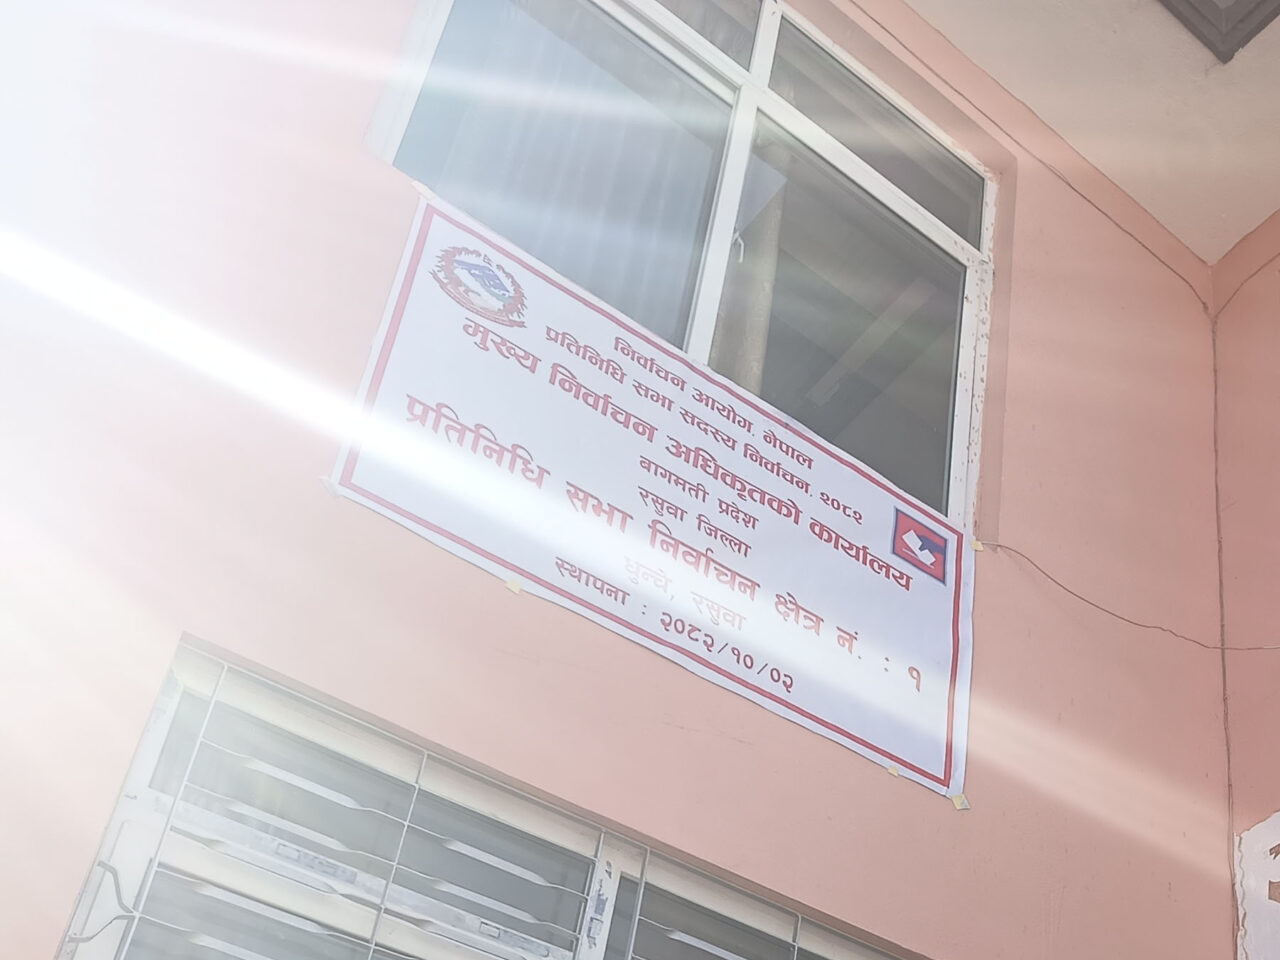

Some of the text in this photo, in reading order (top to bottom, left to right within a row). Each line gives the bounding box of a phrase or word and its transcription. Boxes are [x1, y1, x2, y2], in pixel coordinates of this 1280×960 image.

[462, 317, 913, 591] मुख्य निर्वाचन अधिकृतको कार्यालय
[545, 325, 627, 384] प्रतिनिधि
[632, 379, 675, 412] सभा
[680, 406, 738, 451] सदस्य
[819, 492, 863, 525] २०८२
[613, 336, 688, 392] निर्वाचन
[763, 429, 814, 470] नेपाल
[406, 393, 551, 489] प्रतिनिधि
[565, 480, 634, 534] सभा
[648, 519, 760, 601] निर्वाचन
[774, 592, 824, 636] क्षेत्र
[907, 666, 921, 693] १
[638, 485, 751, 558] रसुवा जिल्ला
[639, 455, 759, 530] बागमती प्रदेश
[555, 556, 630, 606] स्थापना
[660, 612, 794, 693] २०८२/१०/०२
[690, 590, 747, 632] रसुवा
